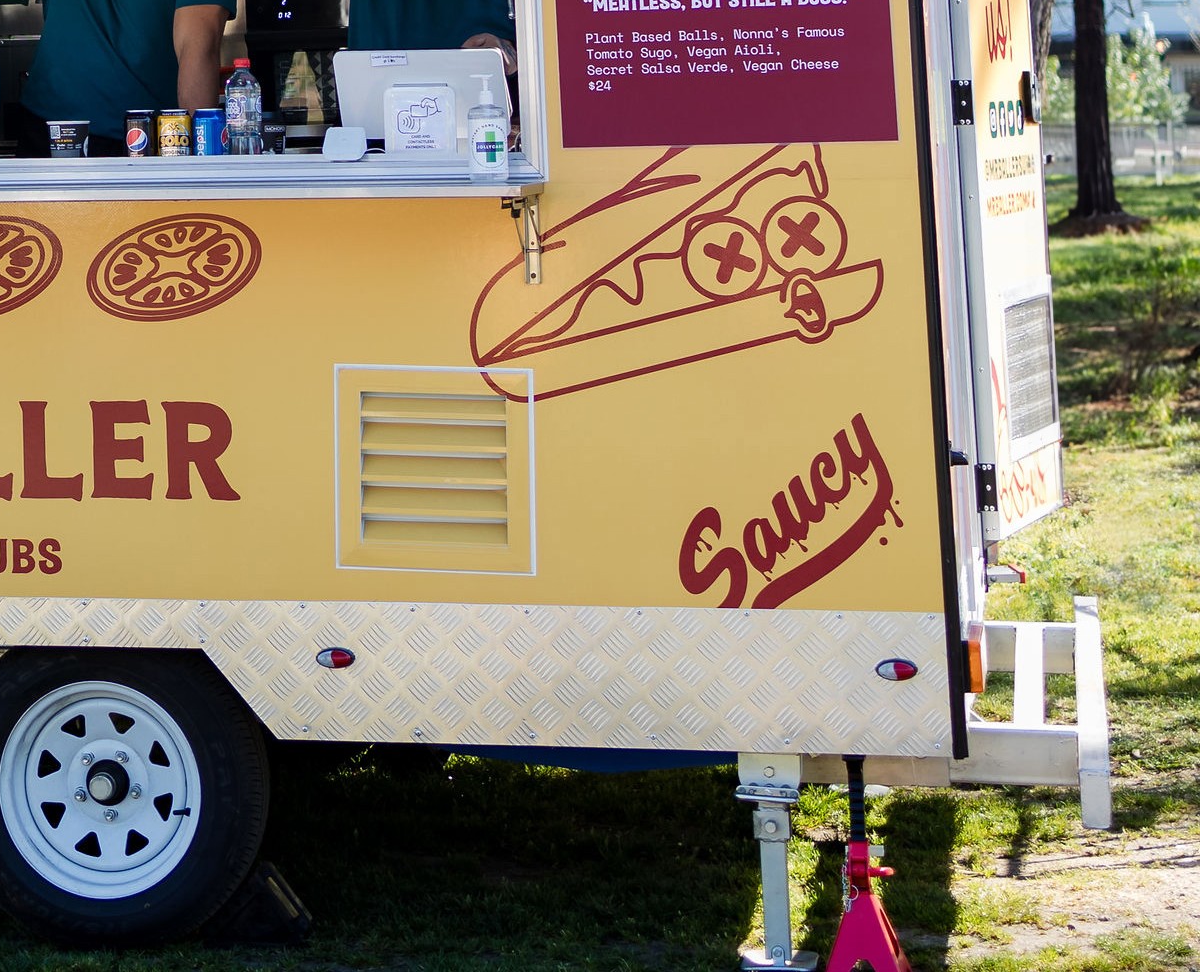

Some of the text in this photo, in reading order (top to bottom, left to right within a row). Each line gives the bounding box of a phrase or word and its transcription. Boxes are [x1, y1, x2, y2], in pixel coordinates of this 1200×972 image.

[585, 25, 845, 44] Plant Based Balls, Nonna’s Famous
[586, 43, 781, 61] Tomato Sugo, Vegan Aioli,
[587, 58, 839, 76] Secret Salsa Verde, Vegan Cheese
[588, 79, 612, 92] $24
[160, 134, 190, 148] SOLO
[678, 412, 904, 609] Saucy
